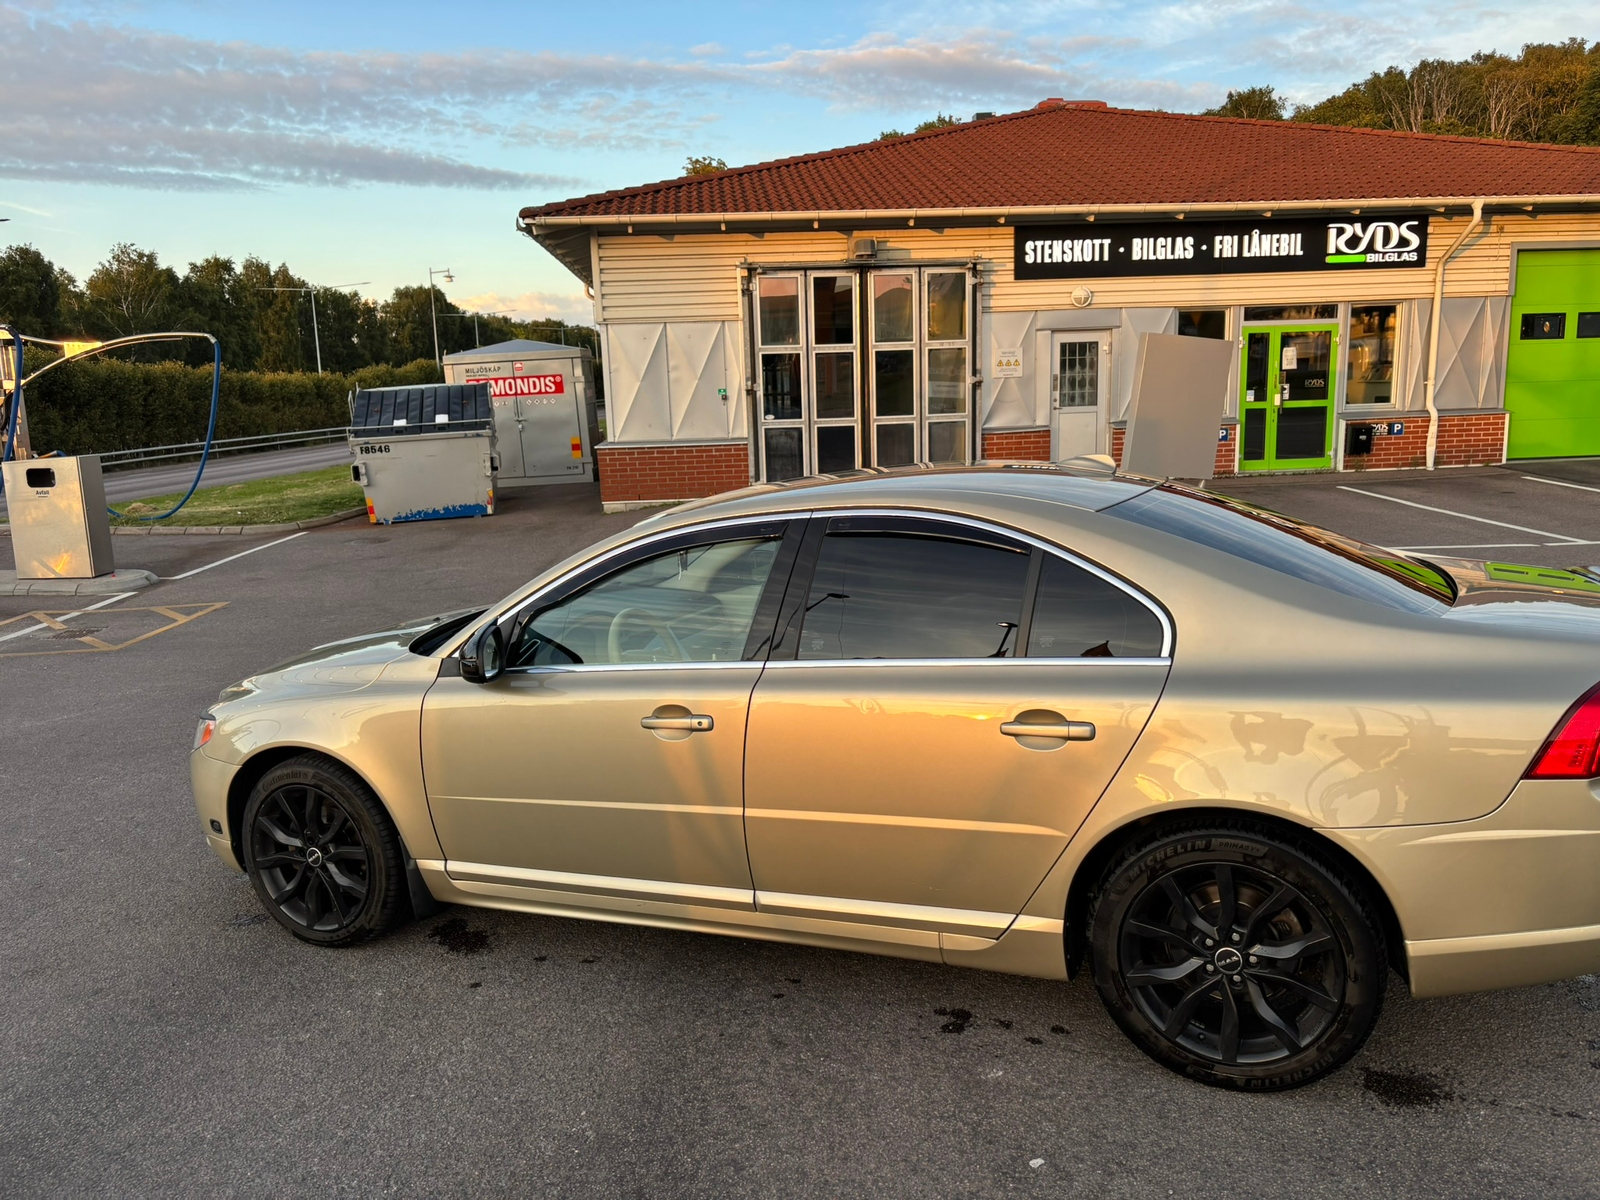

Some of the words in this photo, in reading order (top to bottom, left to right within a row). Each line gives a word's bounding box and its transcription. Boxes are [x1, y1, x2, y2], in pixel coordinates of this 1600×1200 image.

[1326, 221, 1420, 254] RYDS
[1025, 238, 1111, 264] STENSKOTT
[1131, 236, 1194, 261] BILGLAS
[1214, 234, 1238, 258] FRI
[1242, 229, 1304, 257] LÅNEBIL
[1366, 252, 1418, 263] BILGLAS
[465, 365, 502, 374] MILJÖSKÅP
[1394, 423, 1402, 433] P
[1219, 430, 1227, 439] P
[359, 444, 391, 455] F8546
[1129, 840, 1207, 880] MICHELIN
